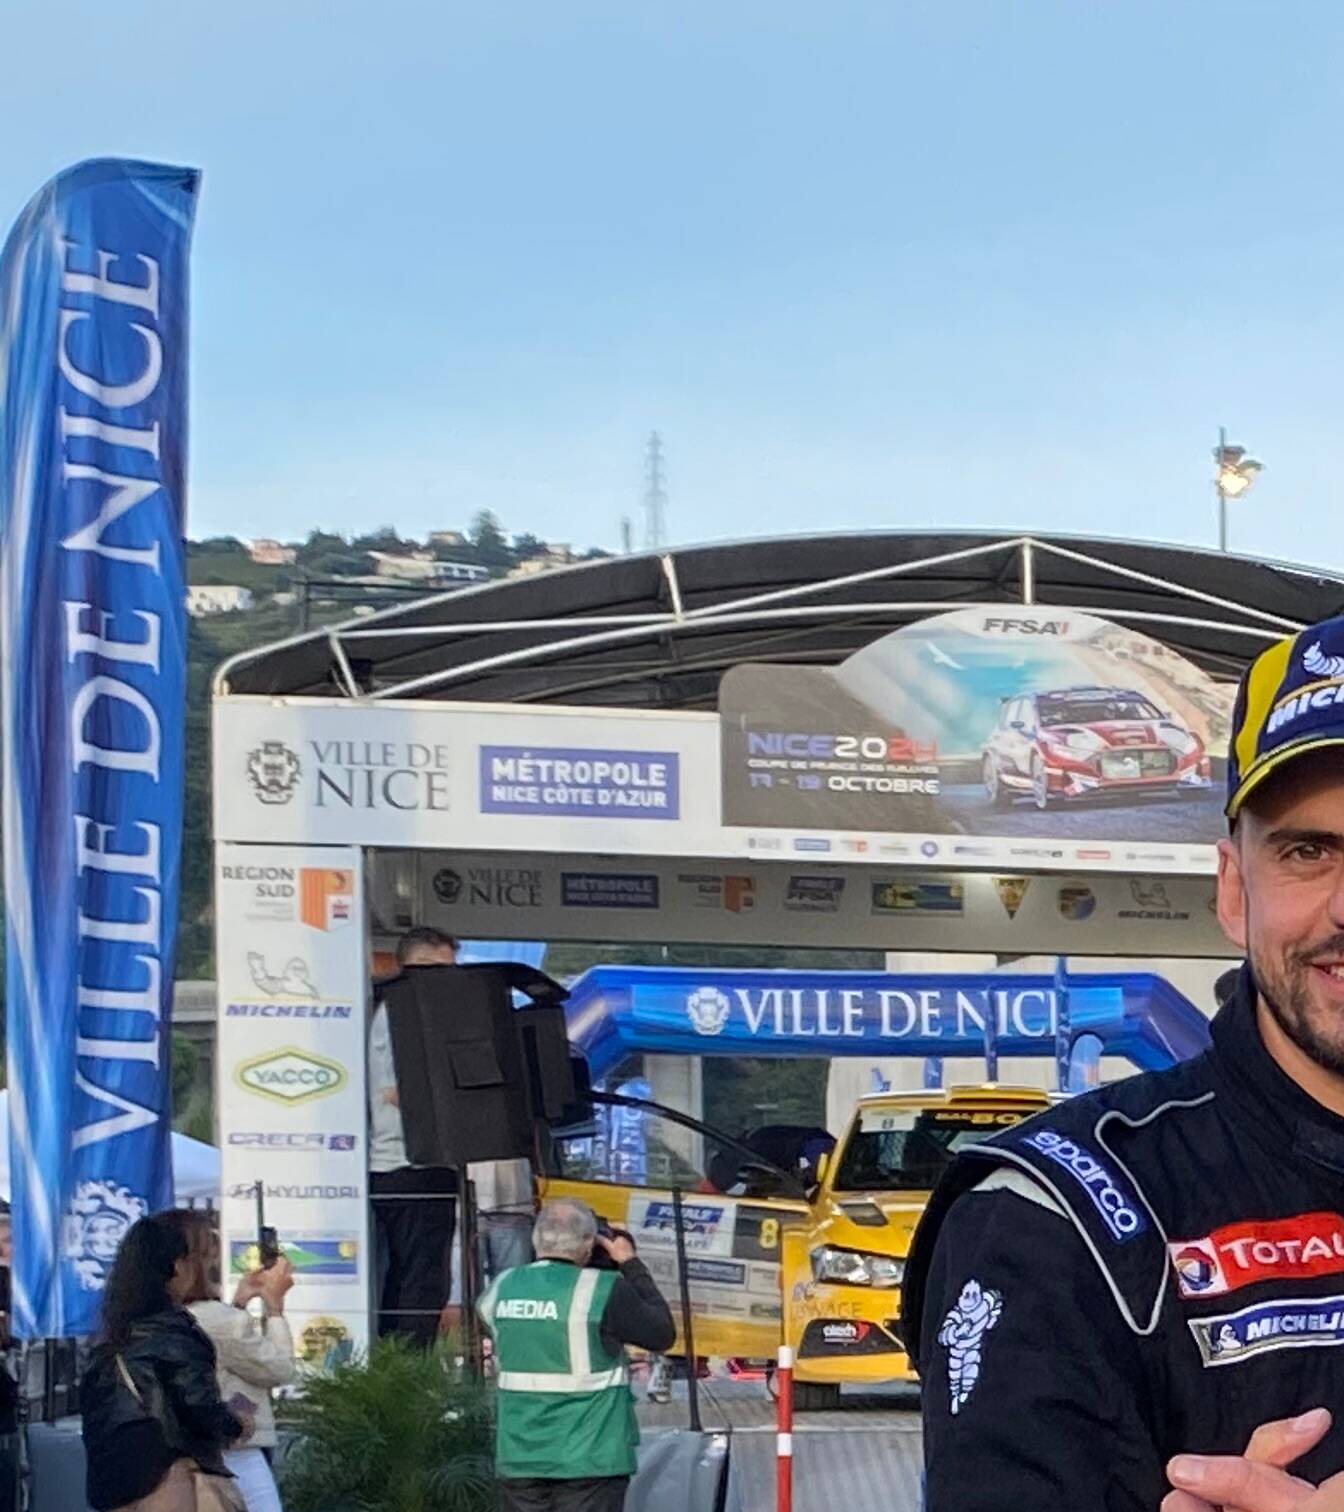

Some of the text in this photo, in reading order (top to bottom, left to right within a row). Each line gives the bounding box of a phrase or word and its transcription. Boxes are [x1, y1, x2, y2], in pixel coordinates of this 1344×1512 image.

[982, 617, 1059, 635] FFSA
[57, 236, 164, 1150] VILLE DE NICE
[310, 741, 449, 769] VILLE DE
[491, 752, 667, 787] MÉTROPOLE
[314, 769, 449, 811] NICE
[492, 783, 668, 809] NICE CÔTE D'AZUR
[828, 775, 940, 795] OCTOBRE
[255, 883, 295, 898] SUD
[468, 884, 542, 908] NICE
[226, 1003, 352, 1019] MICHELIN
[734, 989, 865, 1037] VILLE
[877, 990, 943, 1037] DE
[254, 1068, 331, 1085] YACCO
[1022, 1131, 1139, 1241] sparco
[495, 1299, 558, 1321] MEDIA
